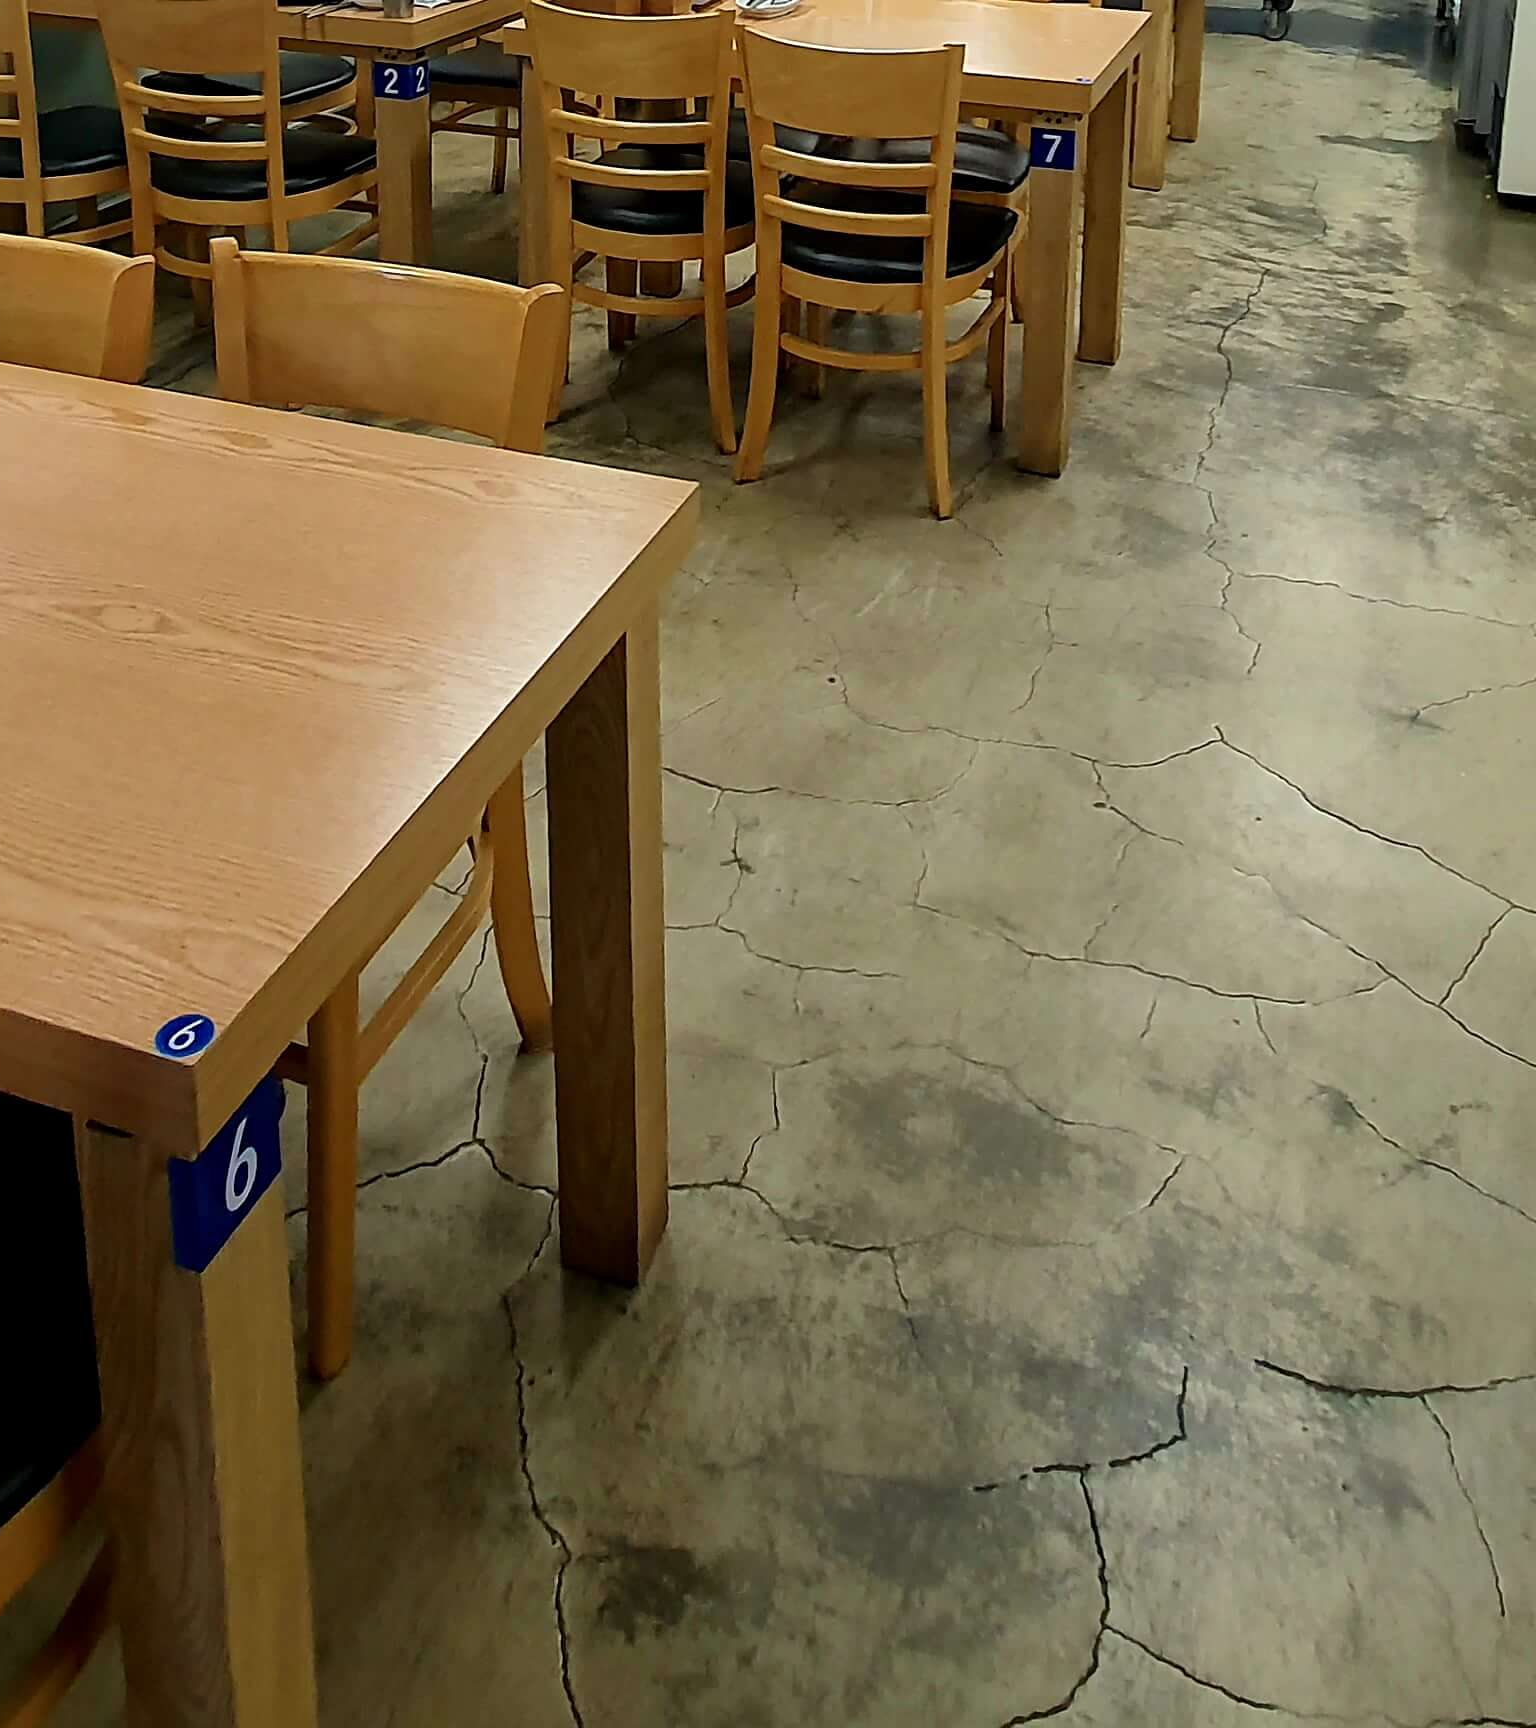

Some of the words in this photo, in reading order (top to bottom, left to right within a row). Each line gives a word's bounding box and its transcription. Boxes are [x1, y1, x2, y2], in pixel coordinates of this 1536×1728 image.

[384, 68, 399, 94] 2
[416, 66, 425, 92] 2
[1042, 134, 1062, 163] 7
[167, 1018, 205, 1050] 6
[225, 1117, 258, 1212] 6
